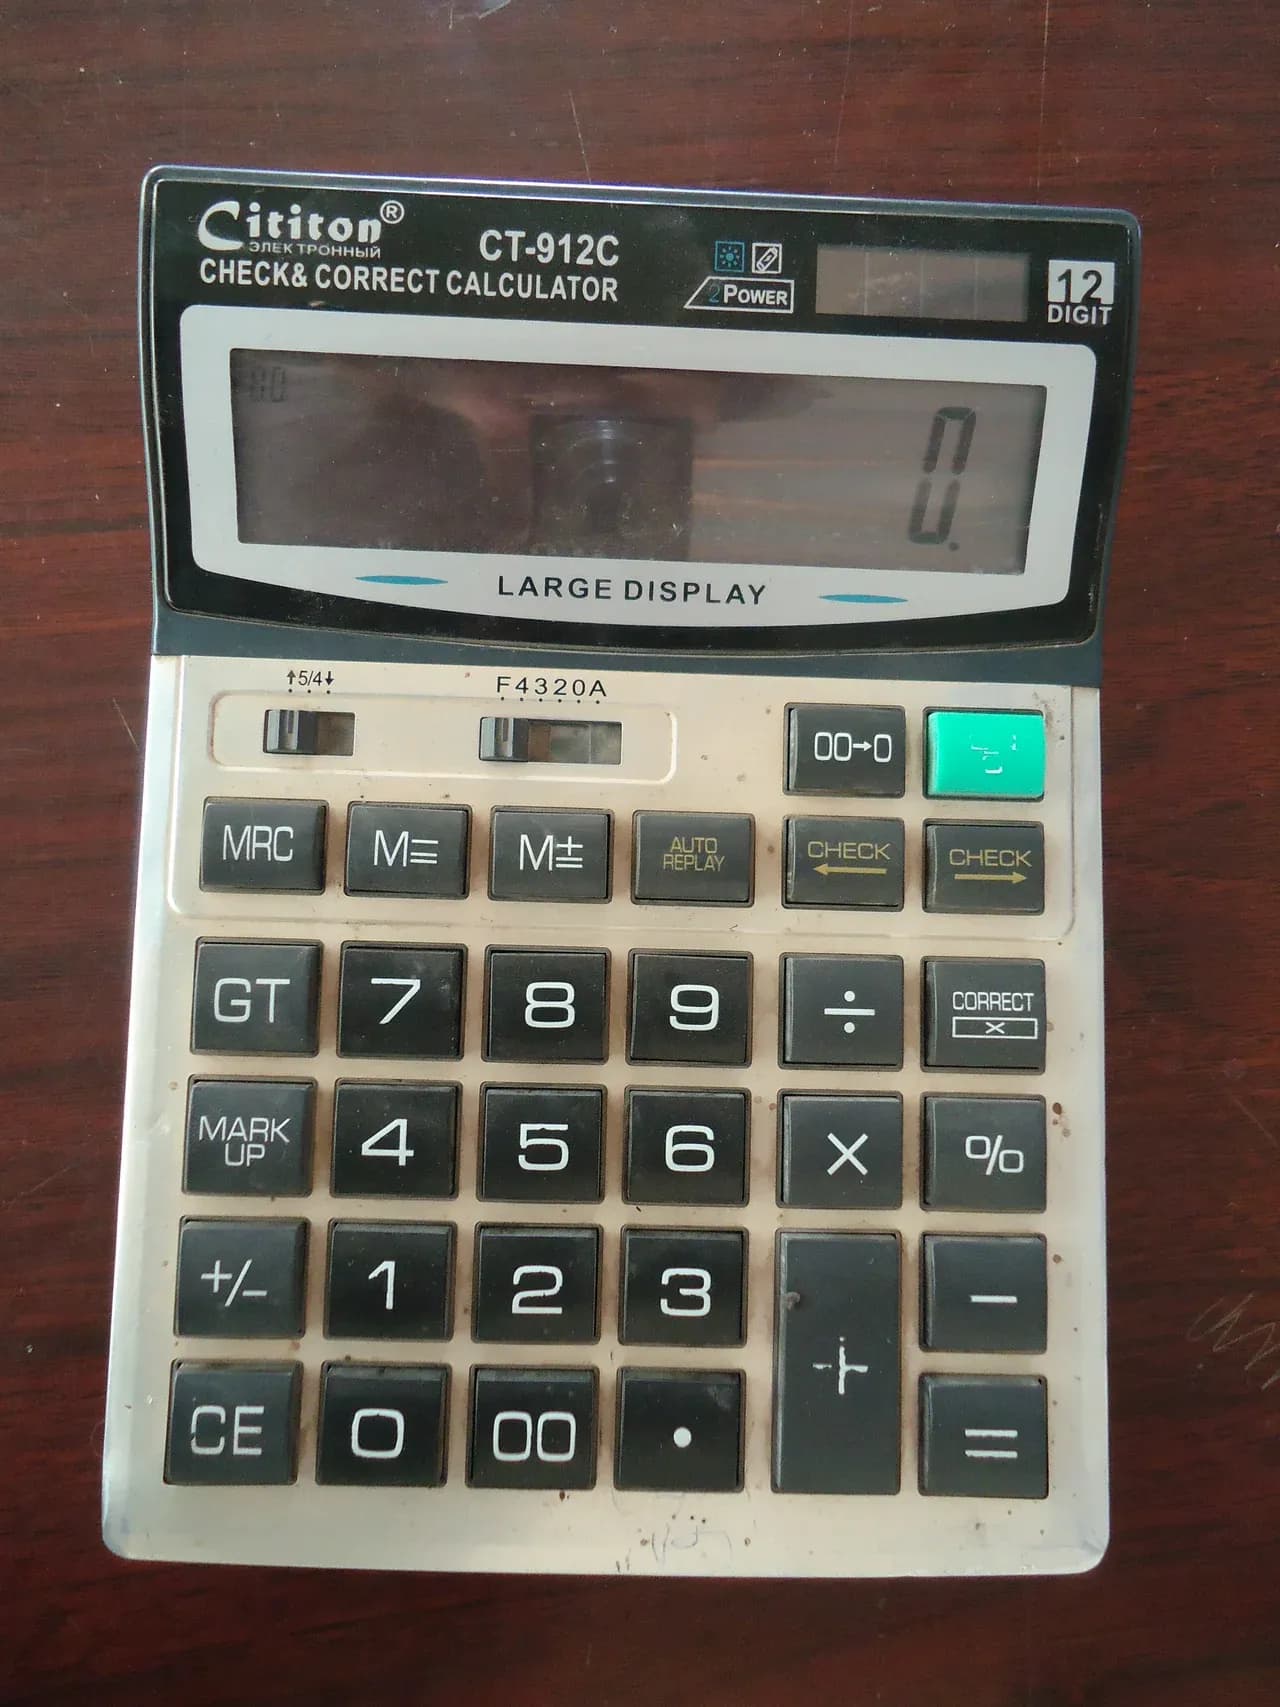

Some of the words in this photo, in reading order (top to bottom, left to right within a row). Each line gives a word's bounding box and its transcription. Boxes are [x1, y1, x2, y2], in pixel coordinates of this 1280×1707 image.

[198, 200, 382, 252] Cititon
[479, 229, 620, 267] CT-912C
[314, 263, 441, 296] CORRECT
[446, 270, 618, 302] CALCULATOR
[723, 283, 788, 306] POWER
[1057, 267, 1104, 300] 12
[1046, 304, 1113, 326] DIGIT
[498, 575, 612, 600] LARGE
[624, 579, 766, 605] DISPLAY
[222, 824, 294, 862] MRC
[663, 851, 725, 872] REPLAY
[669, 836, 718, 854] AUTO
[807, 840, 891, 860] CHECK
[949, 848, 1033, 867] CHECK
[213, 977, 291, 1024] GT
[370, 977, 421, 1025] 7
[524, 981, 576, 1029] 8
[669, 984, 720, 1031] 9
[952, 991, 1035, 1012] CORRECT
[198, 1115, 291, 1144] MARK
[361, 1118, 415, 1166] 4
[518, 1123, 569, 1171] 5
[665, 1124, 715, 1173] 6
[224, 1142, 266, 1167] UP
[965, 1134, 1025, 1176] %
[368, 1260, 396, 1310] 1
[511, 1264, 563, 1315] 2
[660, 1267, 712, 1317] 3
[190, 1404, 265, 1456] CE
[351, 1407, 405, 1459] 0
[492, 1411, 577, 1462] 00
